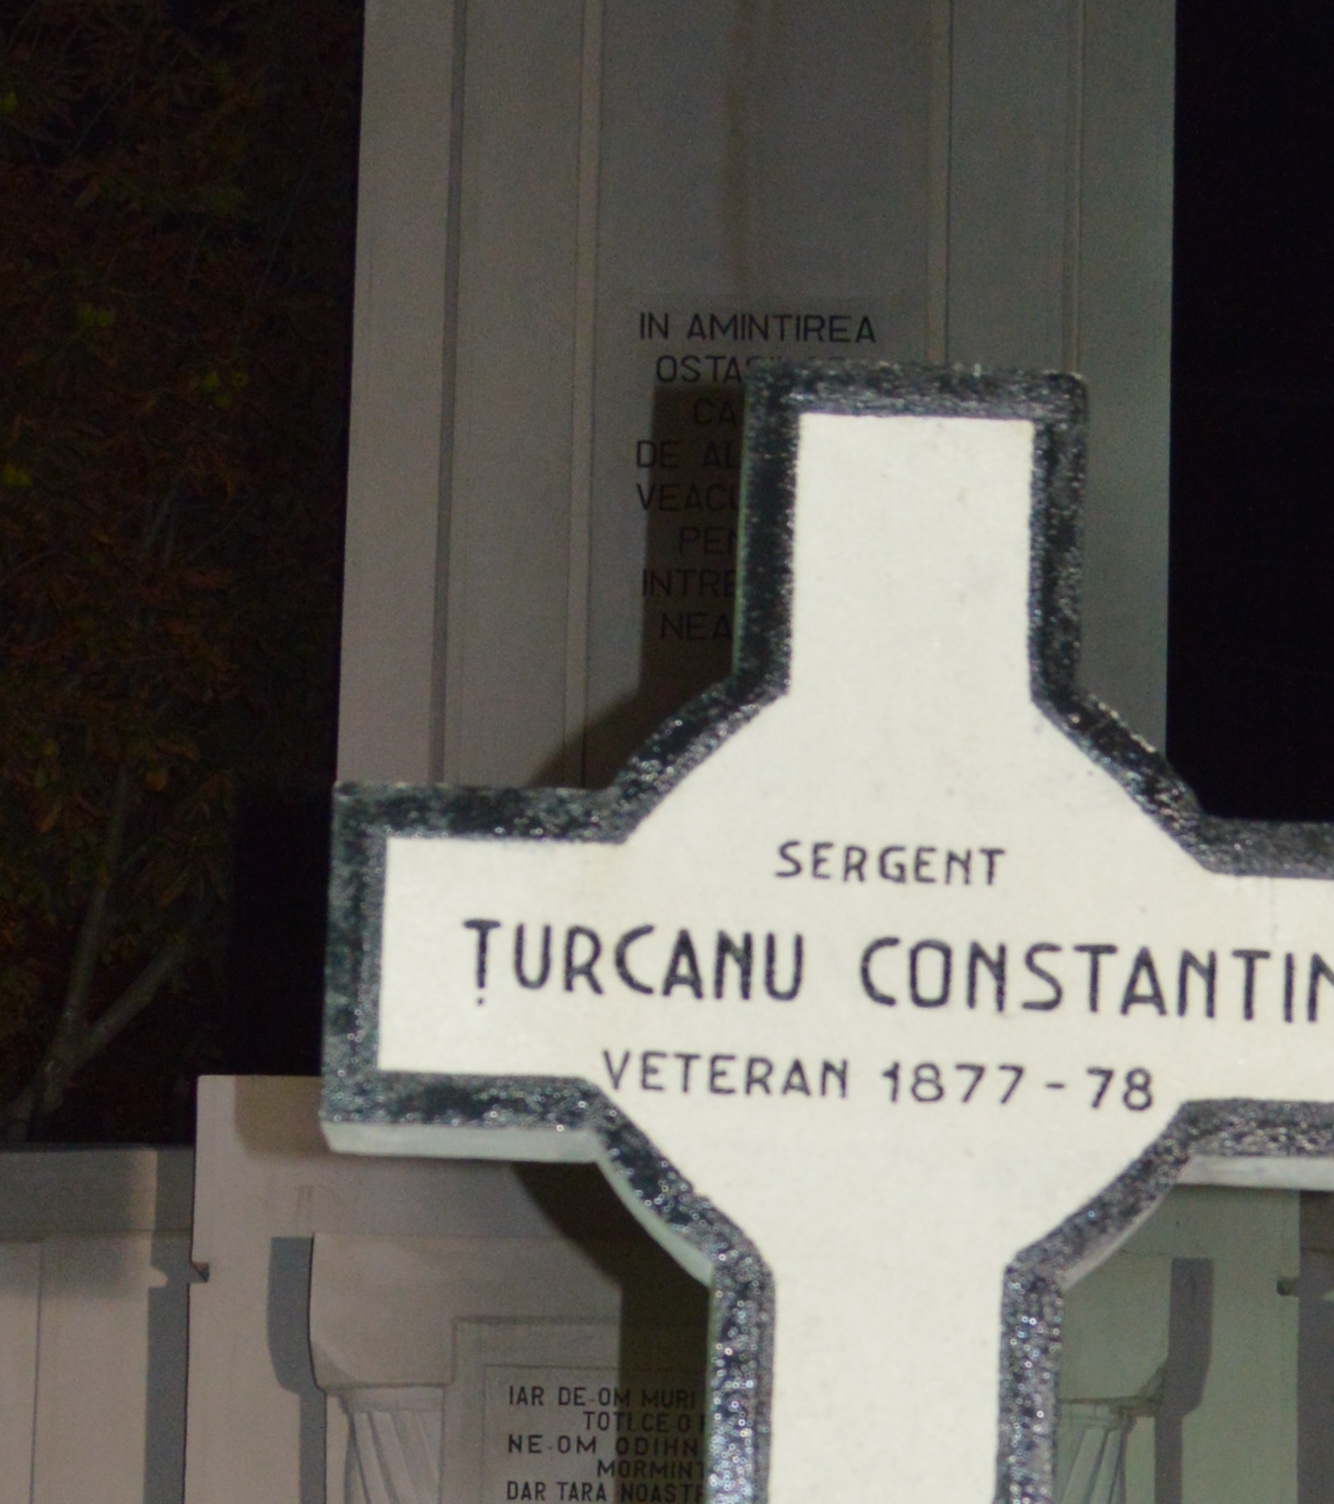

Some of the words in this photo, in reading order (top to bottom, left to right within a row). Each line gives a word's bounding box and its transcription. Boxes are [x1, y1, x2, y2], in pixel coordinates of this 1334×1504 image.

[639, 311, 670, 341] IN
[686, 312, 878, 344] AMINTIREA
[774, 839, 1006, 886] SERGENT
[464, 916, 805, 1007] ȚURCANU
[602, 1048, 850, 1099] VETERAN
[508, 1385, 545, 1406] IAR
[640, 1387, 696, 1409] MURI
[615, 1436, 699, 1457] ODIHN
[596, 1458, 705, 1480] MORMINT
[506, 1480, 547, 1501] DAR
[556, 1481, 608, 1502] TARA
